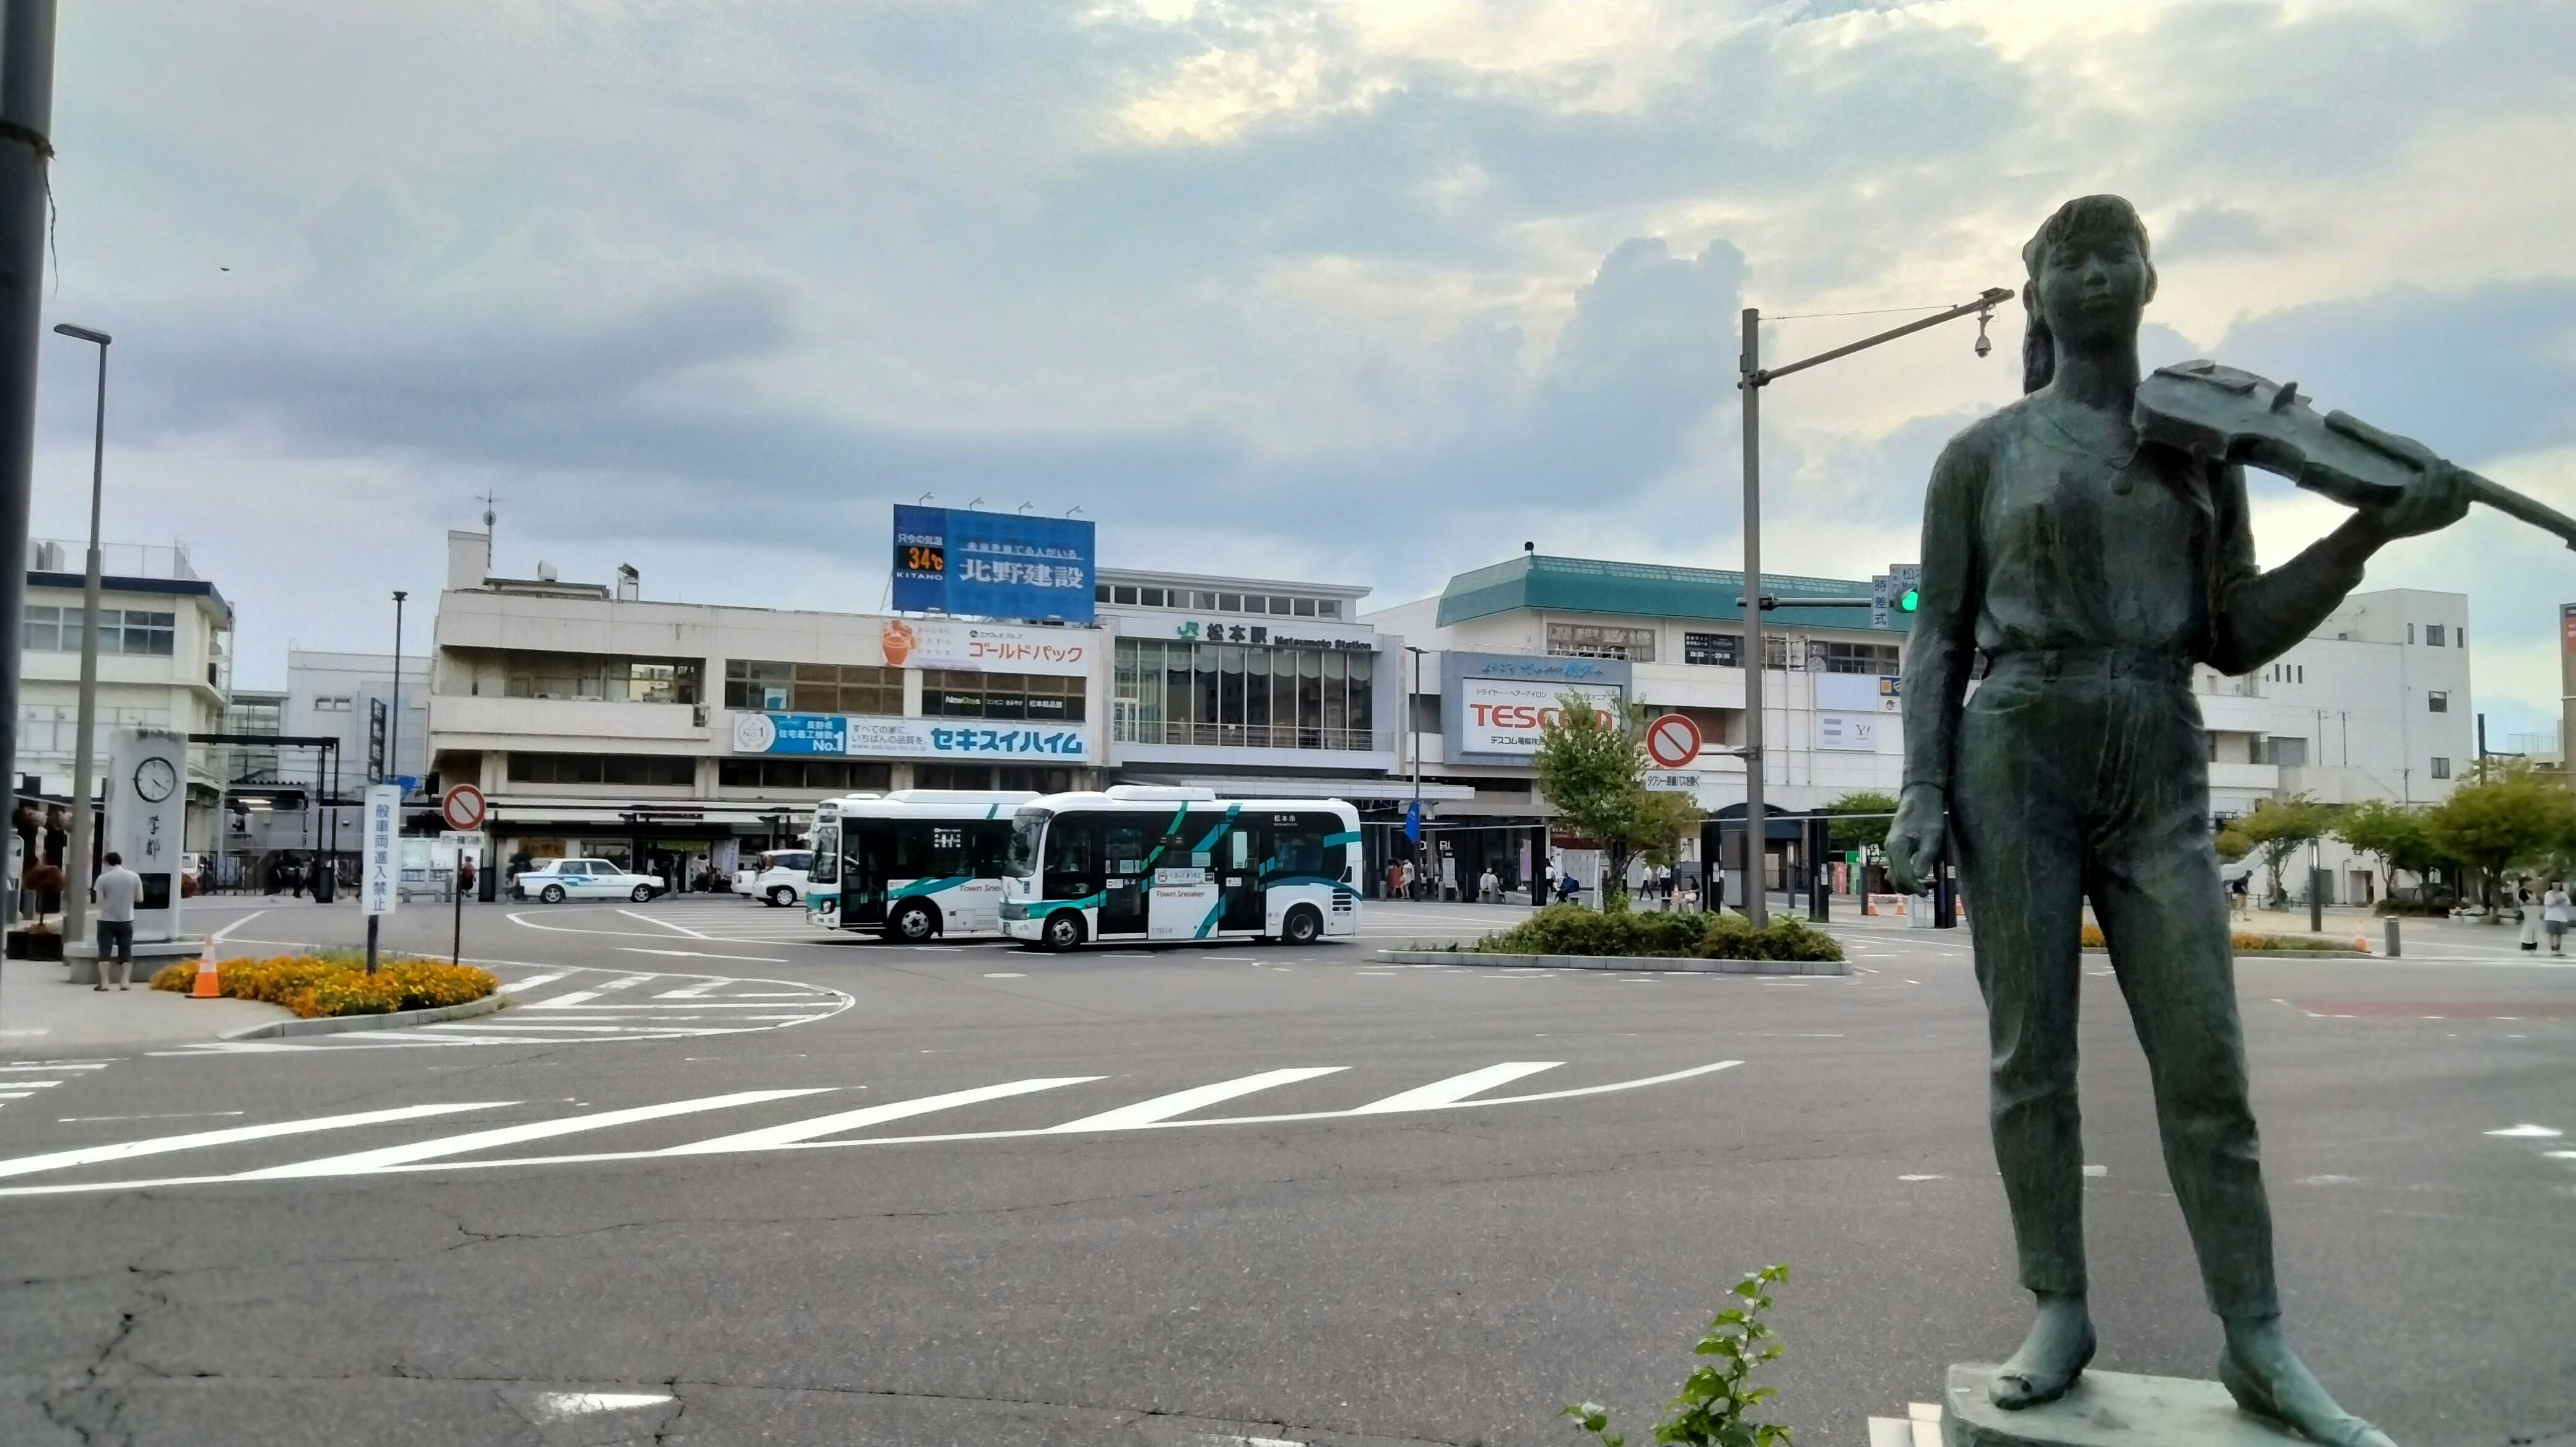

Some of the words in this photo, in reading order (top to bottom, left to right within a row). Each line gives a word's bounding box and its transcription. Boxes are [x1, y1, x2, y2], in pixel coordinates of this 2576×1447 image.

[897, 572, 944, 581] KITANO
[959, 559, 1084, 589] 北野建設
[1901, 567, 1921, 580] 松
[1874, 579, 1887, 626] 時差式
[1177, 621, 1199, 636] JR
[1207, 623, 1268, 644] 松本駅
[969, 642, 1083, 662] ゴールドパック
[1274, 636, 1333, 648] Matsumoto
[1335, 639, 1372, 650] Station
[812, 730, 845, 752] No.1
[931, 727, 1082, 754] セキスイハイム
[1274, 815, 1296, 823] 松本市
[373, 793, 390, 912] 一般車両進入禁止
[985, 884, 1002, 892] Sne
